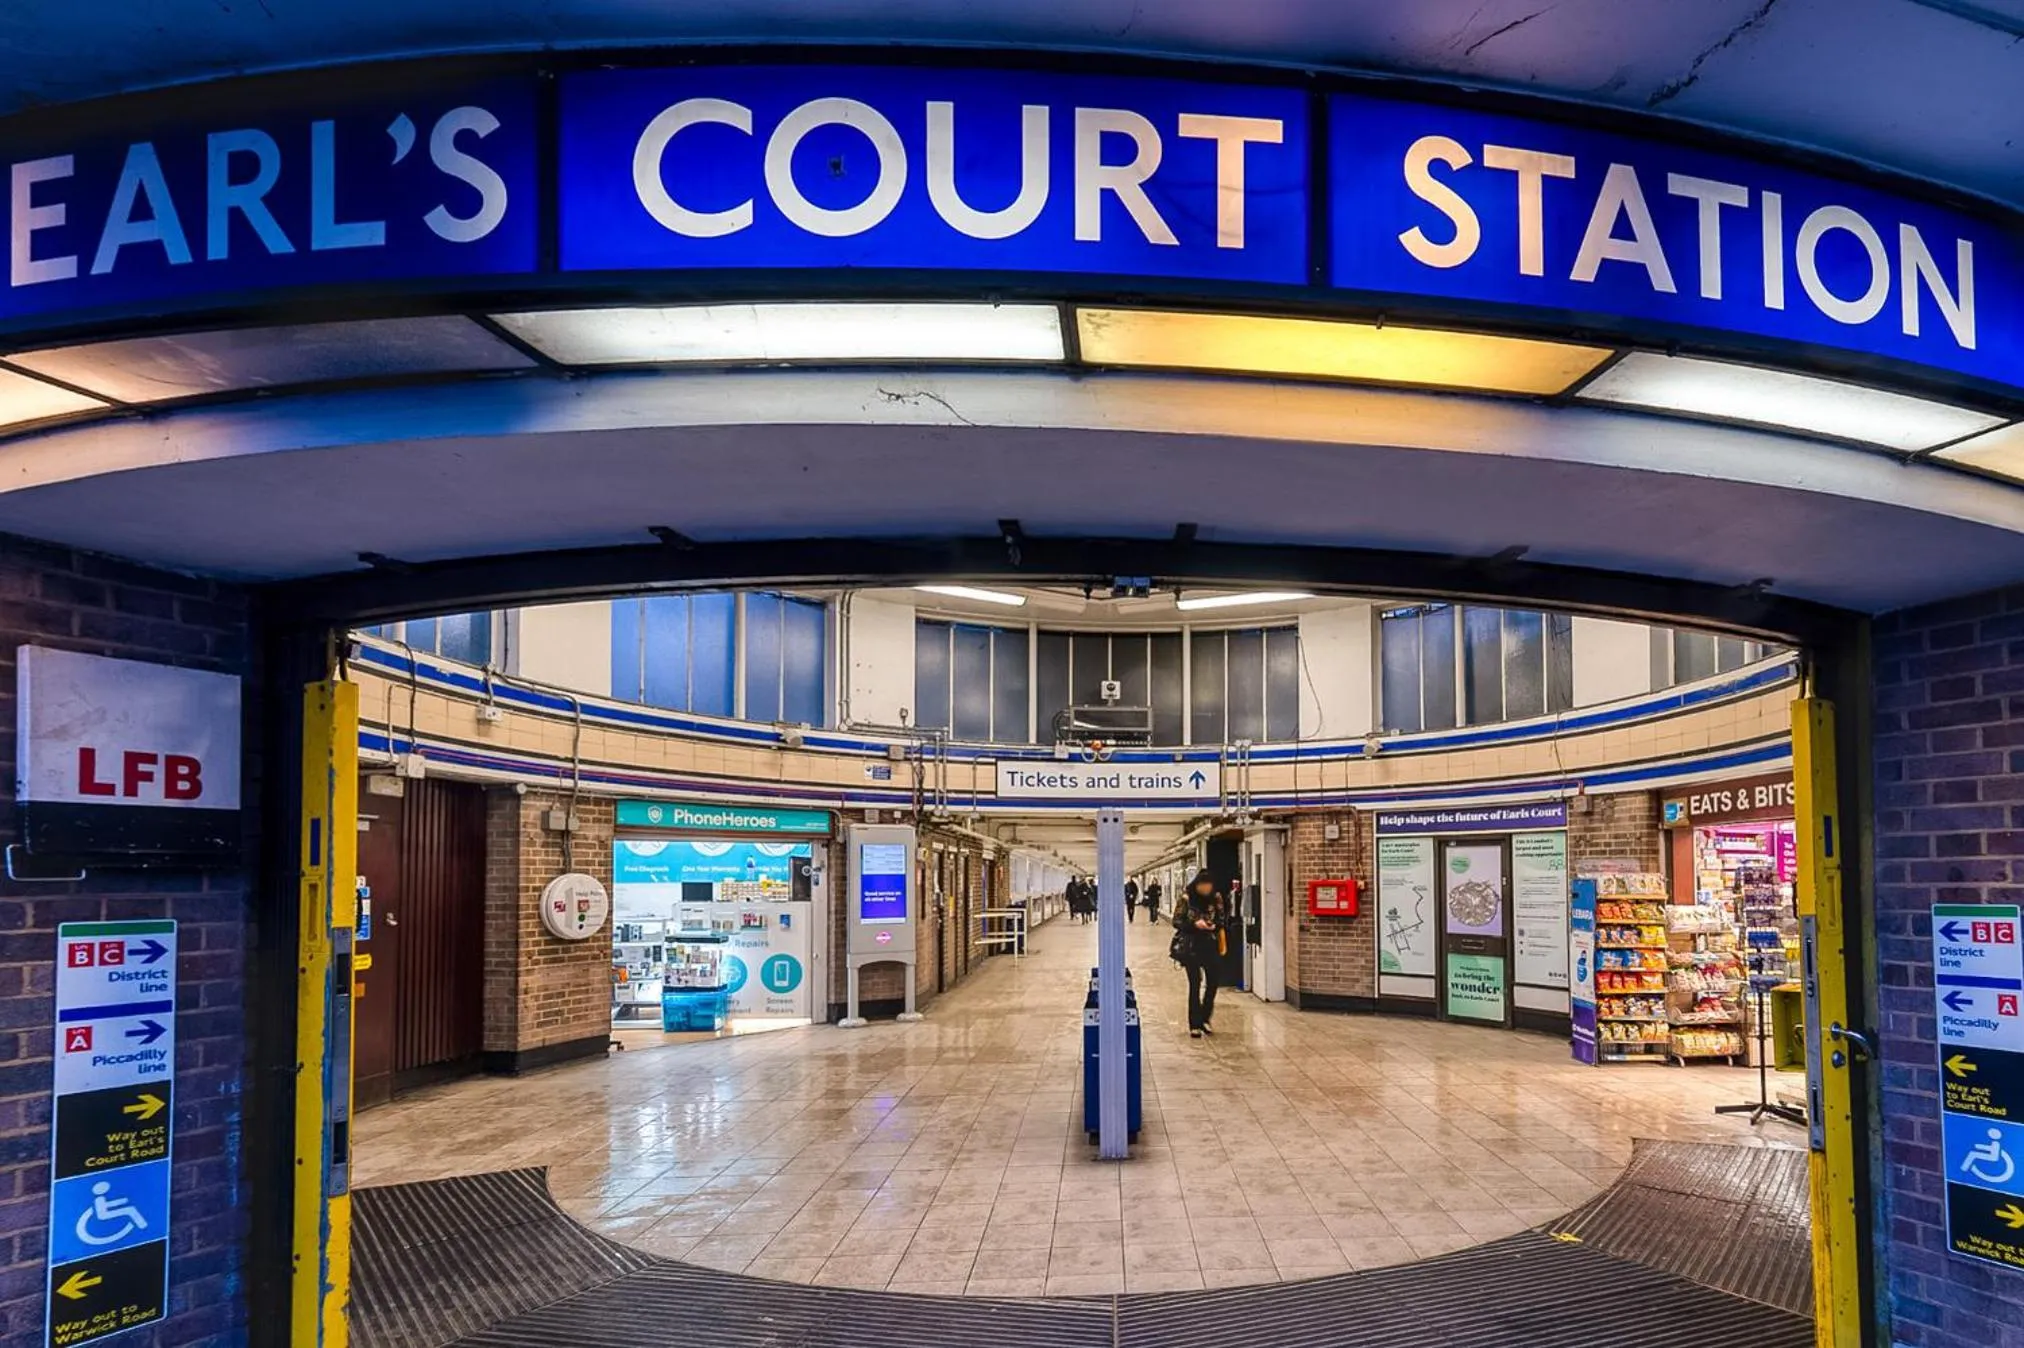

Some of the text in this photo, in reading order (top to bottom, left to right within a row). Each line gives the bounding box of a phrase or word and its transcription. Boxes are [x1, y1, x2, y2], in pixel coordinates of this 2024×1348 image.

[11, 97, 1977, 351] EARL'S COURT STATION
[78, 747, 203, 800] LFB
[1006, 770, 1182, 789] Tickets and trains
[1690, 791, 1732, 816] EATS
[1736, 788, 1750, 810] &
[1755, 782, 1795, 808] BITS
[673, 808, 777, 828] PhoneHeroes
[1380, 806, 1562, 826] Help shape the future of Earls Court
[1977, 929, 2011, 941] B C
[75, 950, 120, 964] B C
[1939, 946, 1985, 957] District
[1939, 959, 1962, 968] line
[108, 969, 169, 982] District
[139, 983, 168, 993] line
[1451, 982, 1500, 995] wonder
[2001, 1002, 2016, 1014] A
[1942, 1015, 2000, 1032] Piccadilly
[1942, 1026, 1965, 1037] line
[70, 1036, 88, 1050] A
[92, 1048, 167, 1066] Piccadilly
[137, 1062, 167, 1074] line
[1946, 1081, 1991, 1096] Way out
[1946, 1091, 1959, 1100] to
[1946, 1099, 2007, 1116] Court Road
[106, 1126, 165, 1144] Way out
[108, 1135, 165, 1153] to Earl's
[85, 1145, 165, 1167] Court Road
[1955, 1240, 2001, 1259] Warwick
[55, 1304, 139, 1333] Way out to
[55, 1306, 157, 1345] Warwick Road
